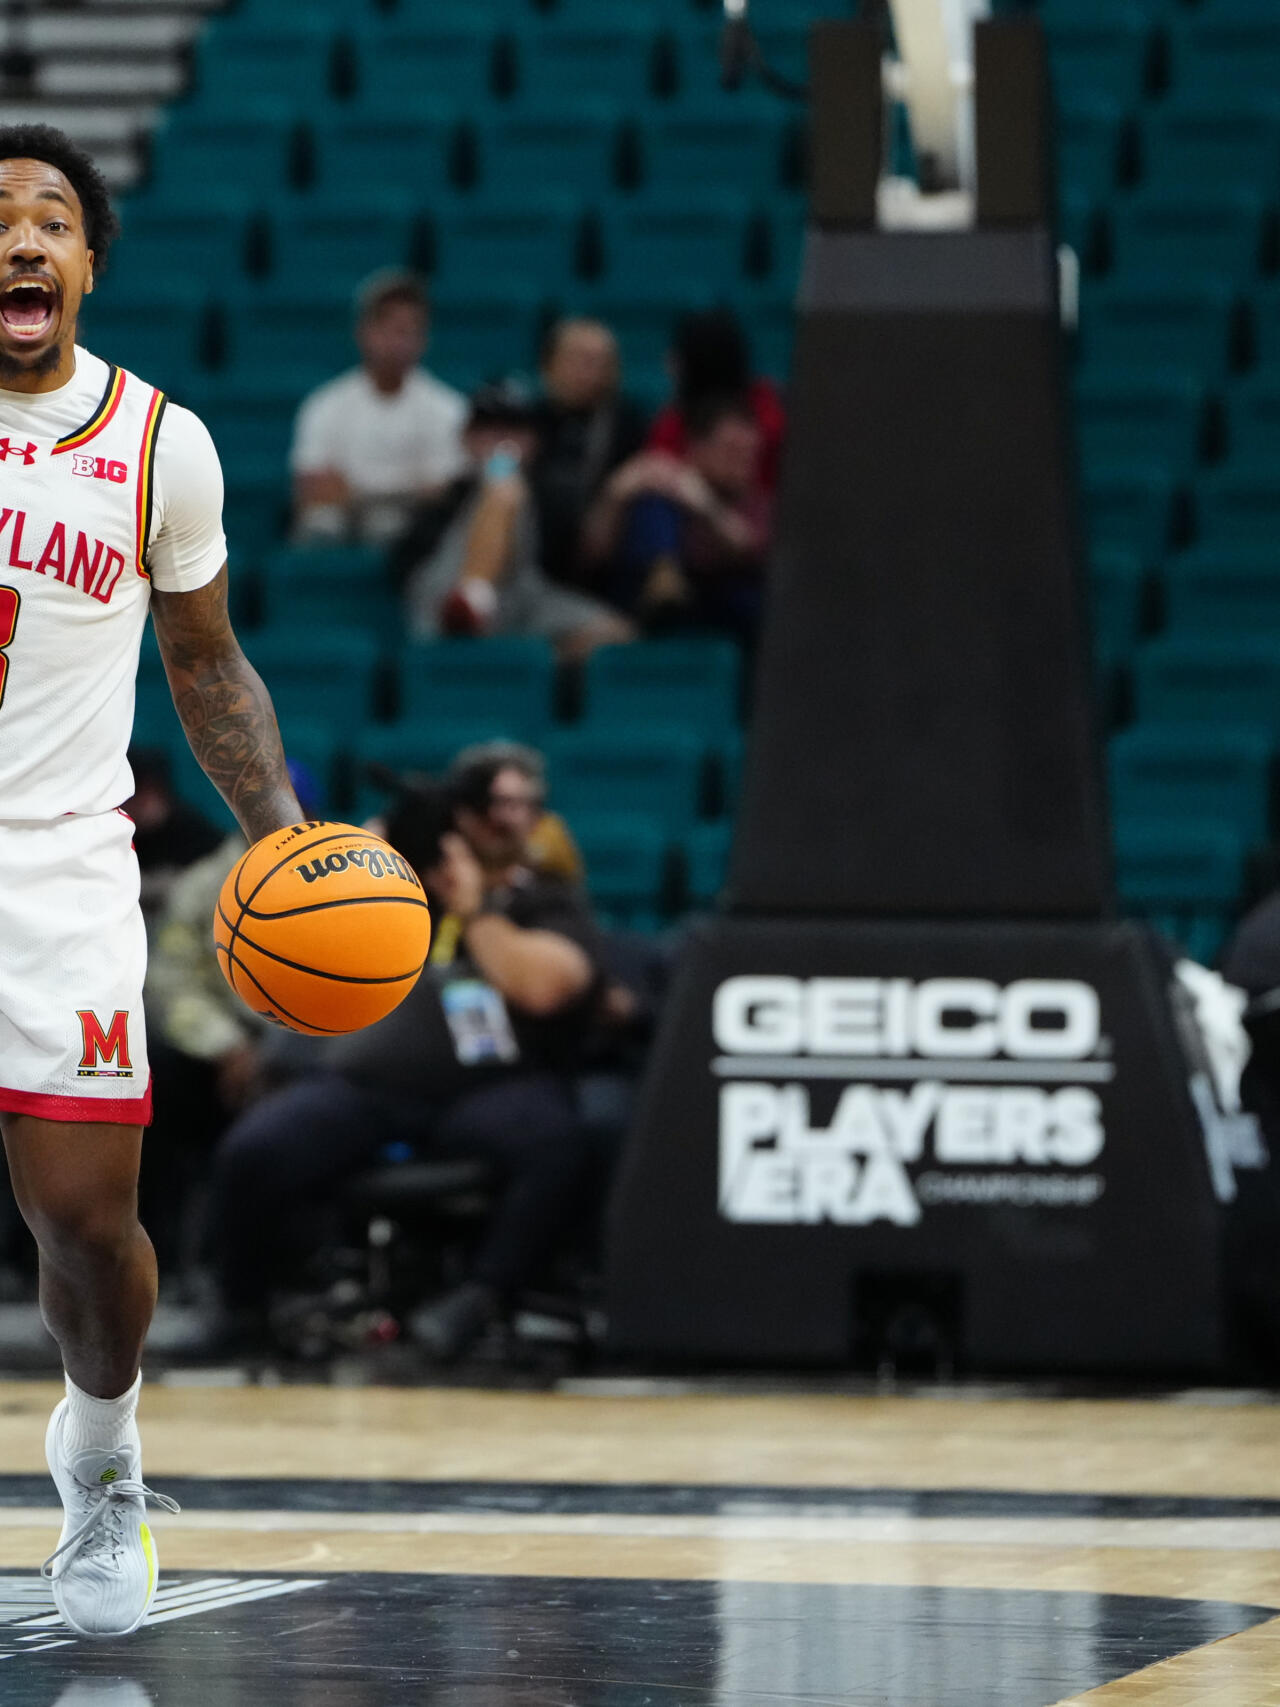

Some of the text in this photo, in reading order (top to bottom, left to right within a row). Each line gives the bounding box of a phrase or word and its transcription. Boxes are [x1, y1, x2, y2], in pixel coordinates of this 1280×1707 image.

[295, 848, 422, 889] Wilson
[75, 1010, 133, 1068] M
[711, 974, 1101, 1059] GEICO
[718, 1081, 1106, 1168] PLAYERS
[720, 1152, 922, 1228] ERA
